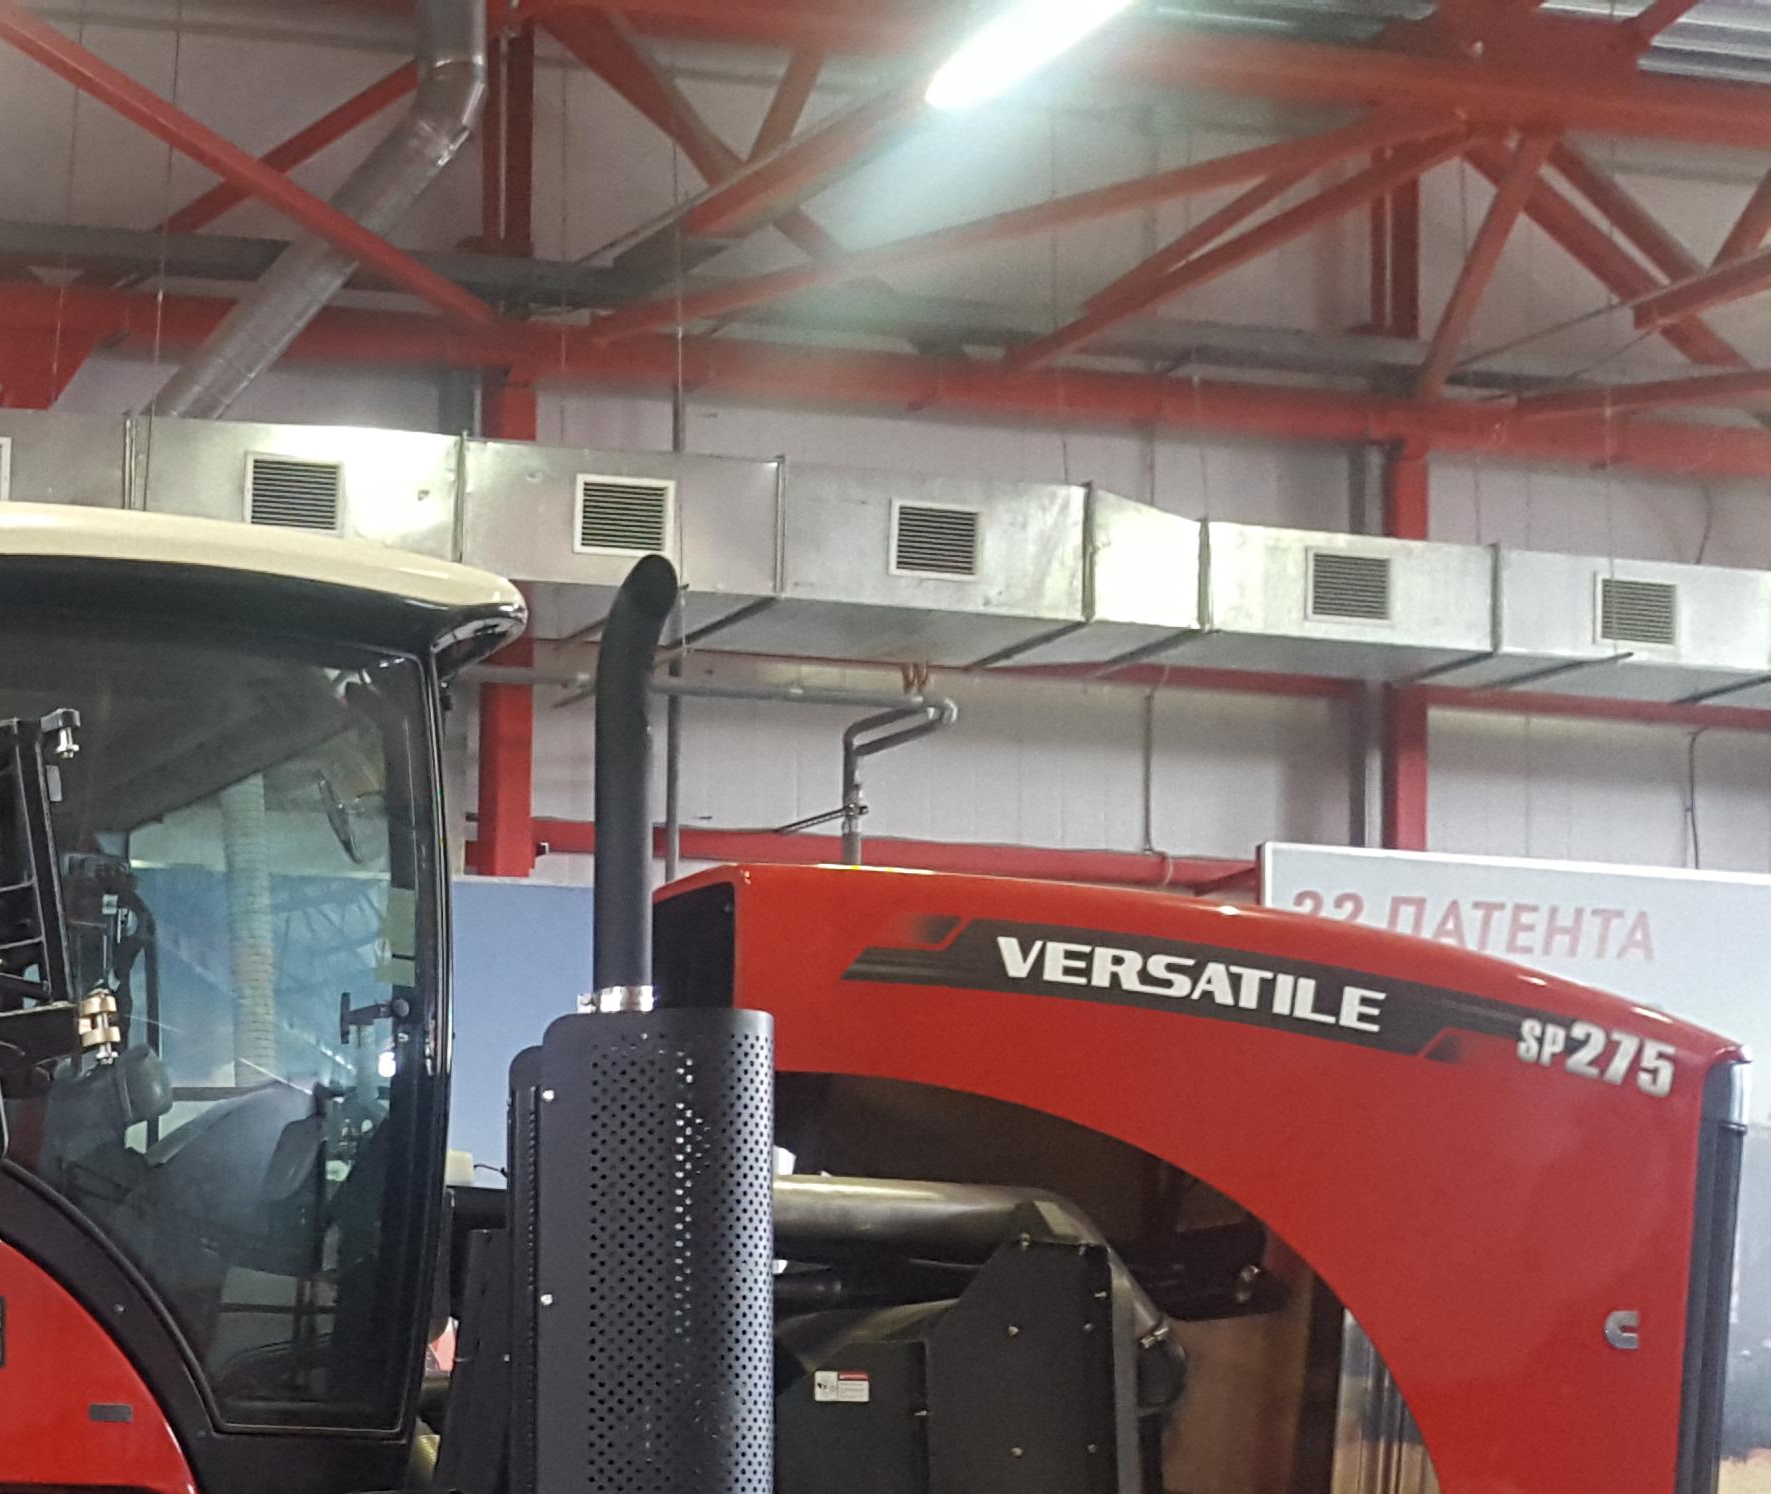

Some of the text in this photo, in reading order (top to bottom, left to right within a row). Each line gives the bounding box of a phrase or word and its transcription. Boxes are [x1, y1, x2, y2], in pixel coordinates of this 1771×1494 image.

[1387, 895, 1657, 962] ПАТЕНТА
[997, 935, 1387, 1033] VERSATILE
[1516, 1018, 1678, 1099] SP275
